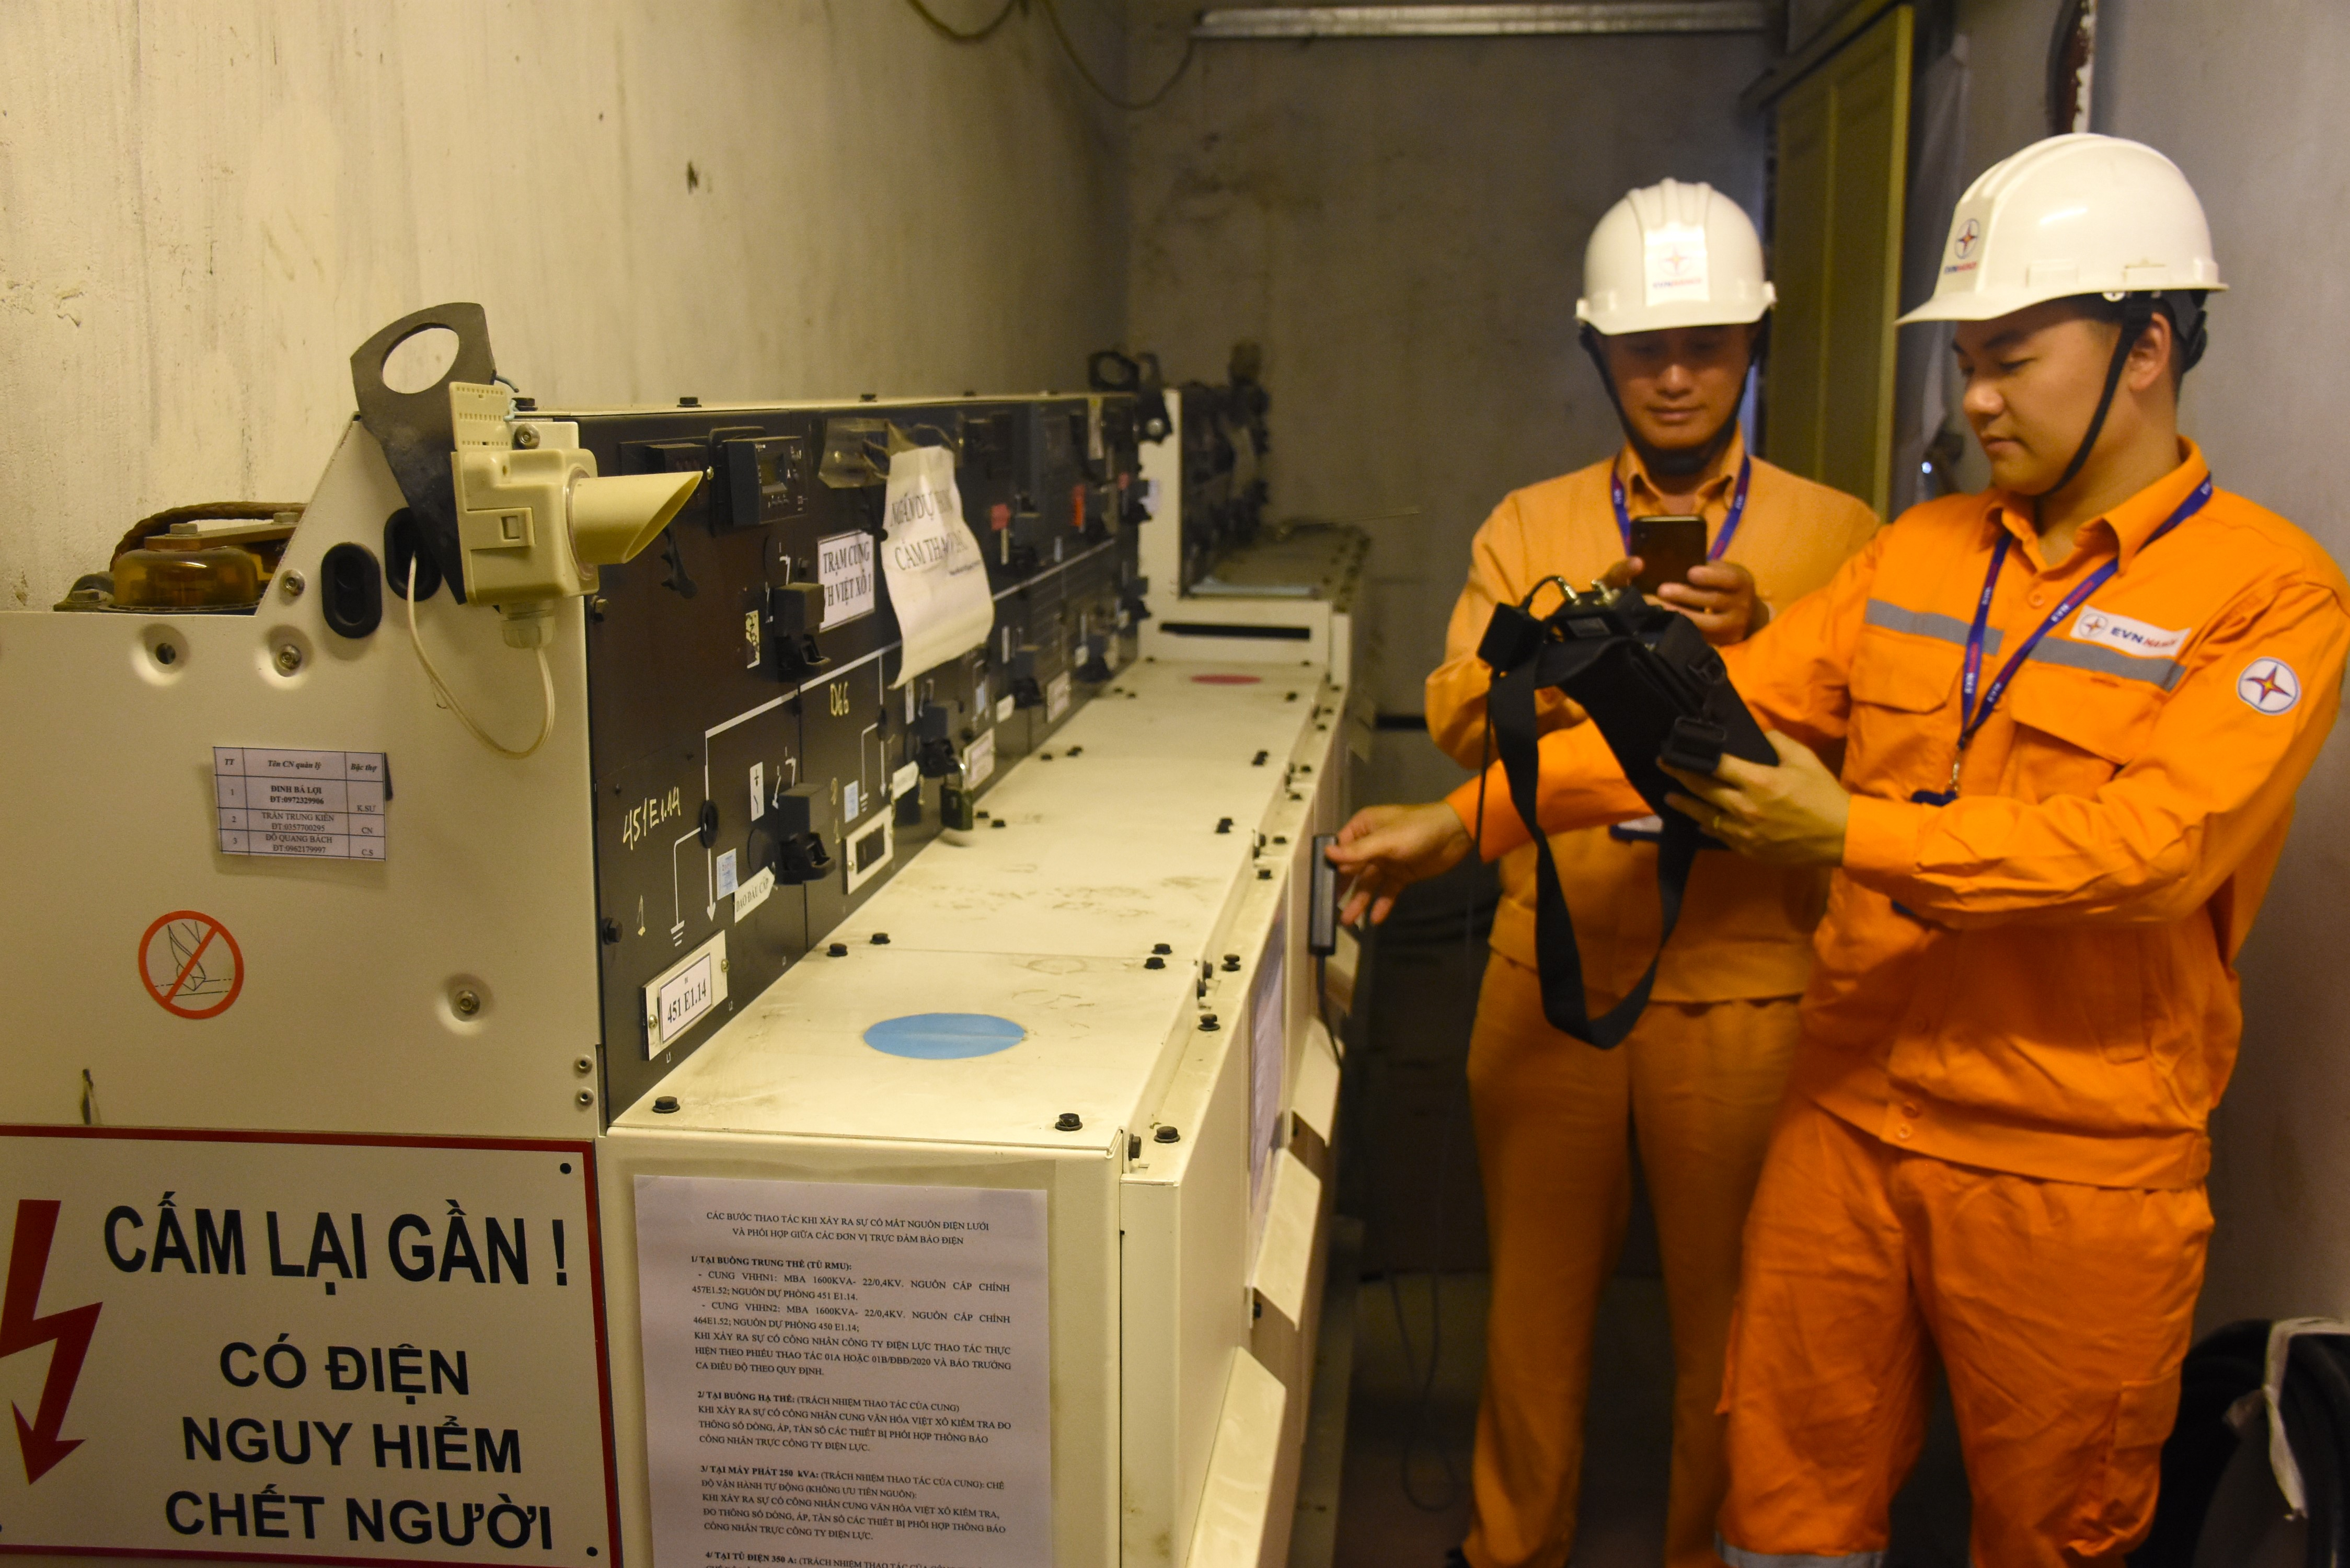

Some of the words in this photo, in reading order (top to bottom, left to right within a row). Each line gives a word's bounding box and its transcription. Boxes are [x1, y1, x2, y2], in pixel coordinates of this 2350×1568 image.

[351, 763, 363, 771] Bậc
[365, 764, 377, 773] thợ
[294, 785, 305, 793] BÁ
[285, 813, 313, 821] TRUNG
[310, 835, 332, 843] BÁCH
[667, 997, 682, 1023] 451
[684, 978, 706, 1012] E1.14
[706, 1210, 725, 1220] CÁC
[781, 1214, 799, 1223] TÁC
[820, 1215, 839, 1225] XẢY
[105, 1191, 246, 1275] CẤM
[266, 1210, 367, 1295] LẠI
[388, 1199, 528, 1285] GẦN
[552, 1219, 567, 1286] !
[732, 1227, 745, 1236] VÀ
[815, 1230, 834, 1239] CÁC
[858, 1233, 868, 1242] VỊ
[896, 1233, 918, 1243] ĐẢM
[920, 1234, 940, 1243] BẢO
[751, 1258, 784, 1266] TRUNG
[807, 1259, 822, 1270] (TỦ
[824, 1262, 852, 1271] RMU):
[742, 1273, 777, 1282] VHHN1:
[813, 1276, 856, 1285] 1600KVA-
[978, 1281, 1010, 1292] CHÍNH
[784, 1288, 815, 1298] PHÒNG
[745, 1304, 780, 1312] VHHN2:
[816, 1307, 858, 1316] 1600KVA-
[979, 1312, 1010, 1322] CHÍNH
[784, 1319, 816, 1330] PHÒNG
[834, 1324, 859, 1333] E1.14;
[713, 1331, 733, 1341] XẢY
[783, 1334, 809, 1344] CÔNG
[812, 1335, 839, 1346] NHÂN
[842, 1337, 868, 1347] CÔNG
[934, 1343, 960, 1352] THAO
[963, 1343, 982, 1352] TÁC
[719, 1348, 744, 1356] THEO
[803, 1350, 822, 1360] TÁC
[934, 1357, 947, 1366] VÀ
[950, 1357, 970, 1367] BÁO
[220, 1333, 307, 1388] CÓ
[325, 1344, 469, 1404] ĐIỆN
[750, 1365, 775, 1373] THEO
[776, 1366, 797, 1376] QUY
[798, 1367, 824, 1377] ĐỊNH.
[182, 1416, 353, 1466] NGUY
[374, 1415, 522, 1473] HIỂM
[166, 1483, 325, 1539] CHẾT
[346, 1493, 553, 1550] NGƯỜI
